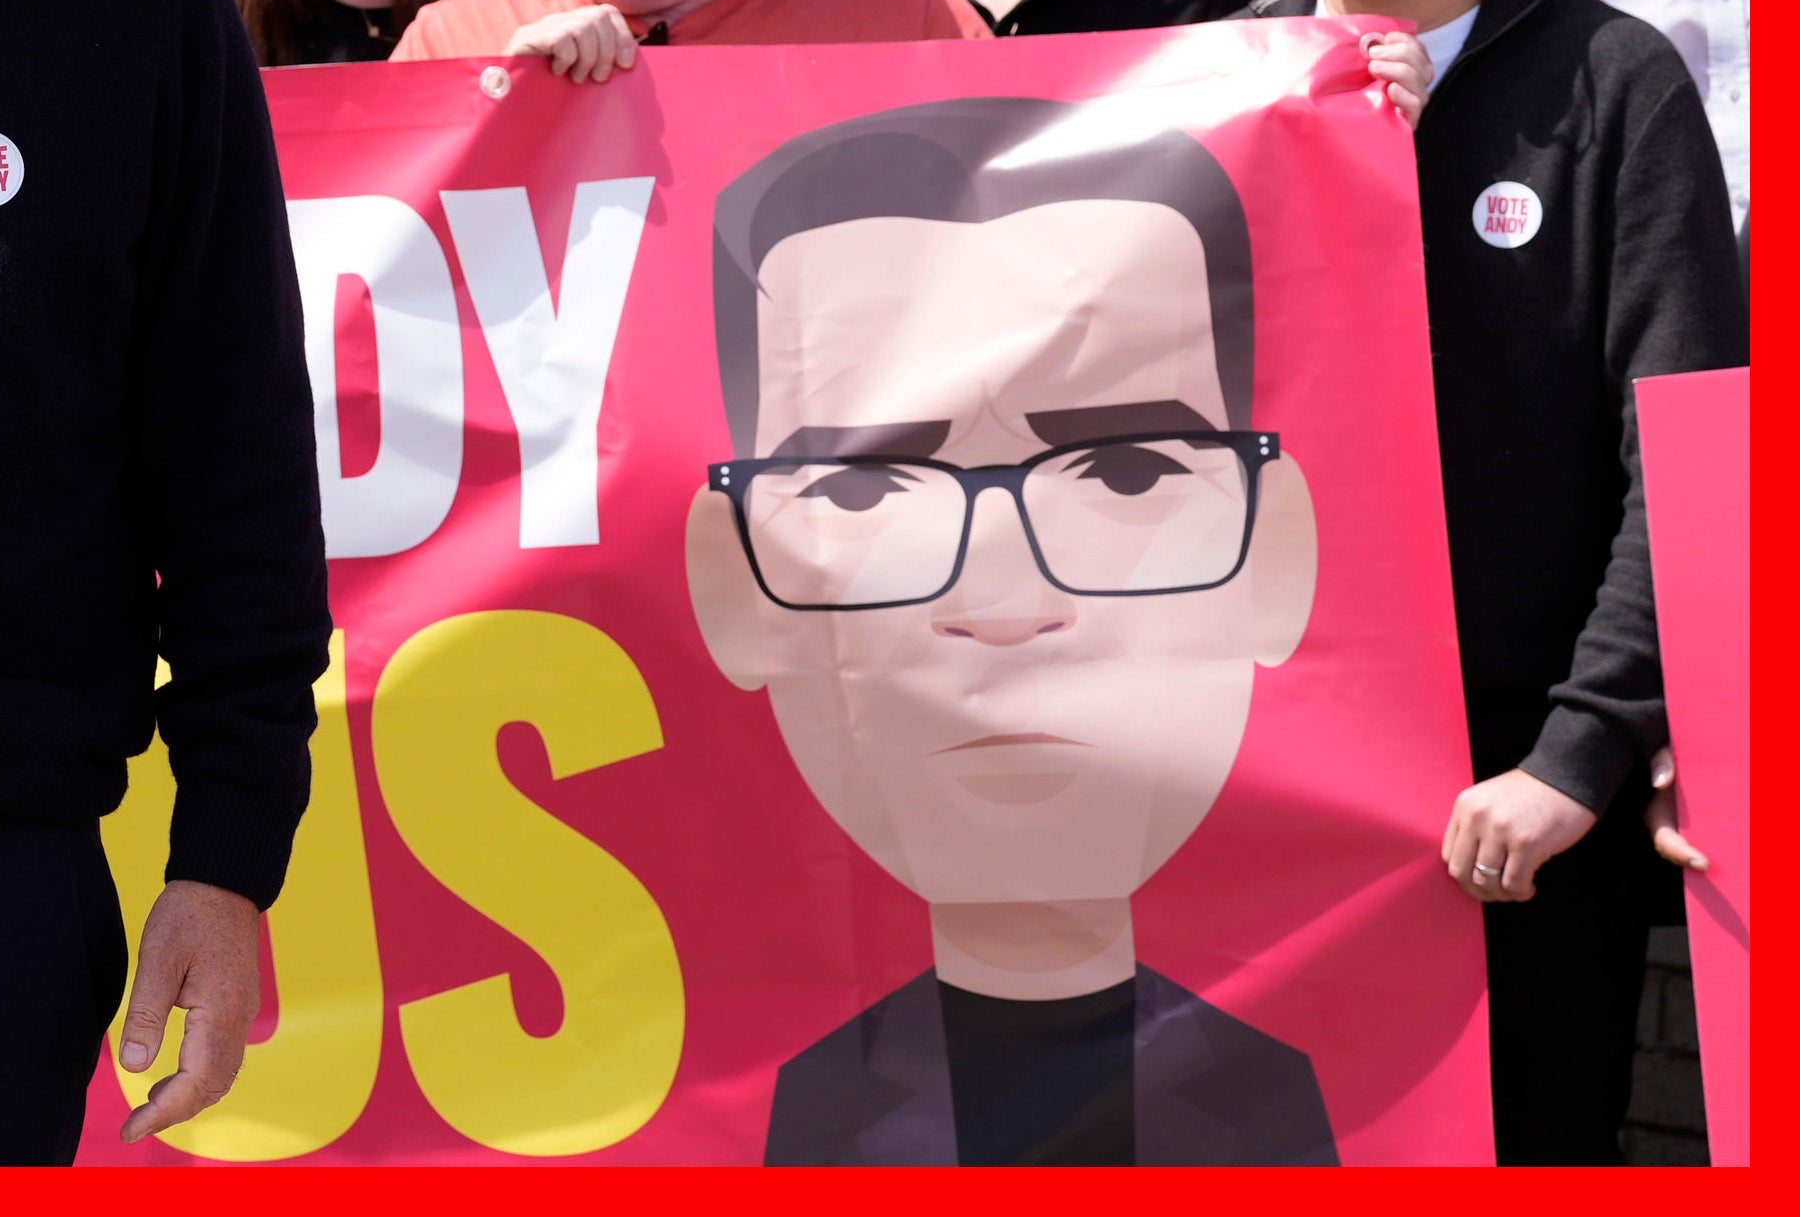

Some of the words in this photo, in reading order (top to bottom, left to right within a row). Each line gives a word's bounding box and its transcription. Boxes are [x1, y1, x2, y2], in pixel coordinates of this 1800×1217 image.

[1486, 195, 1530, 216] VOTE
[1484, 216, 1527, 235] ANDY
[285, 175, 655, 560] DY
